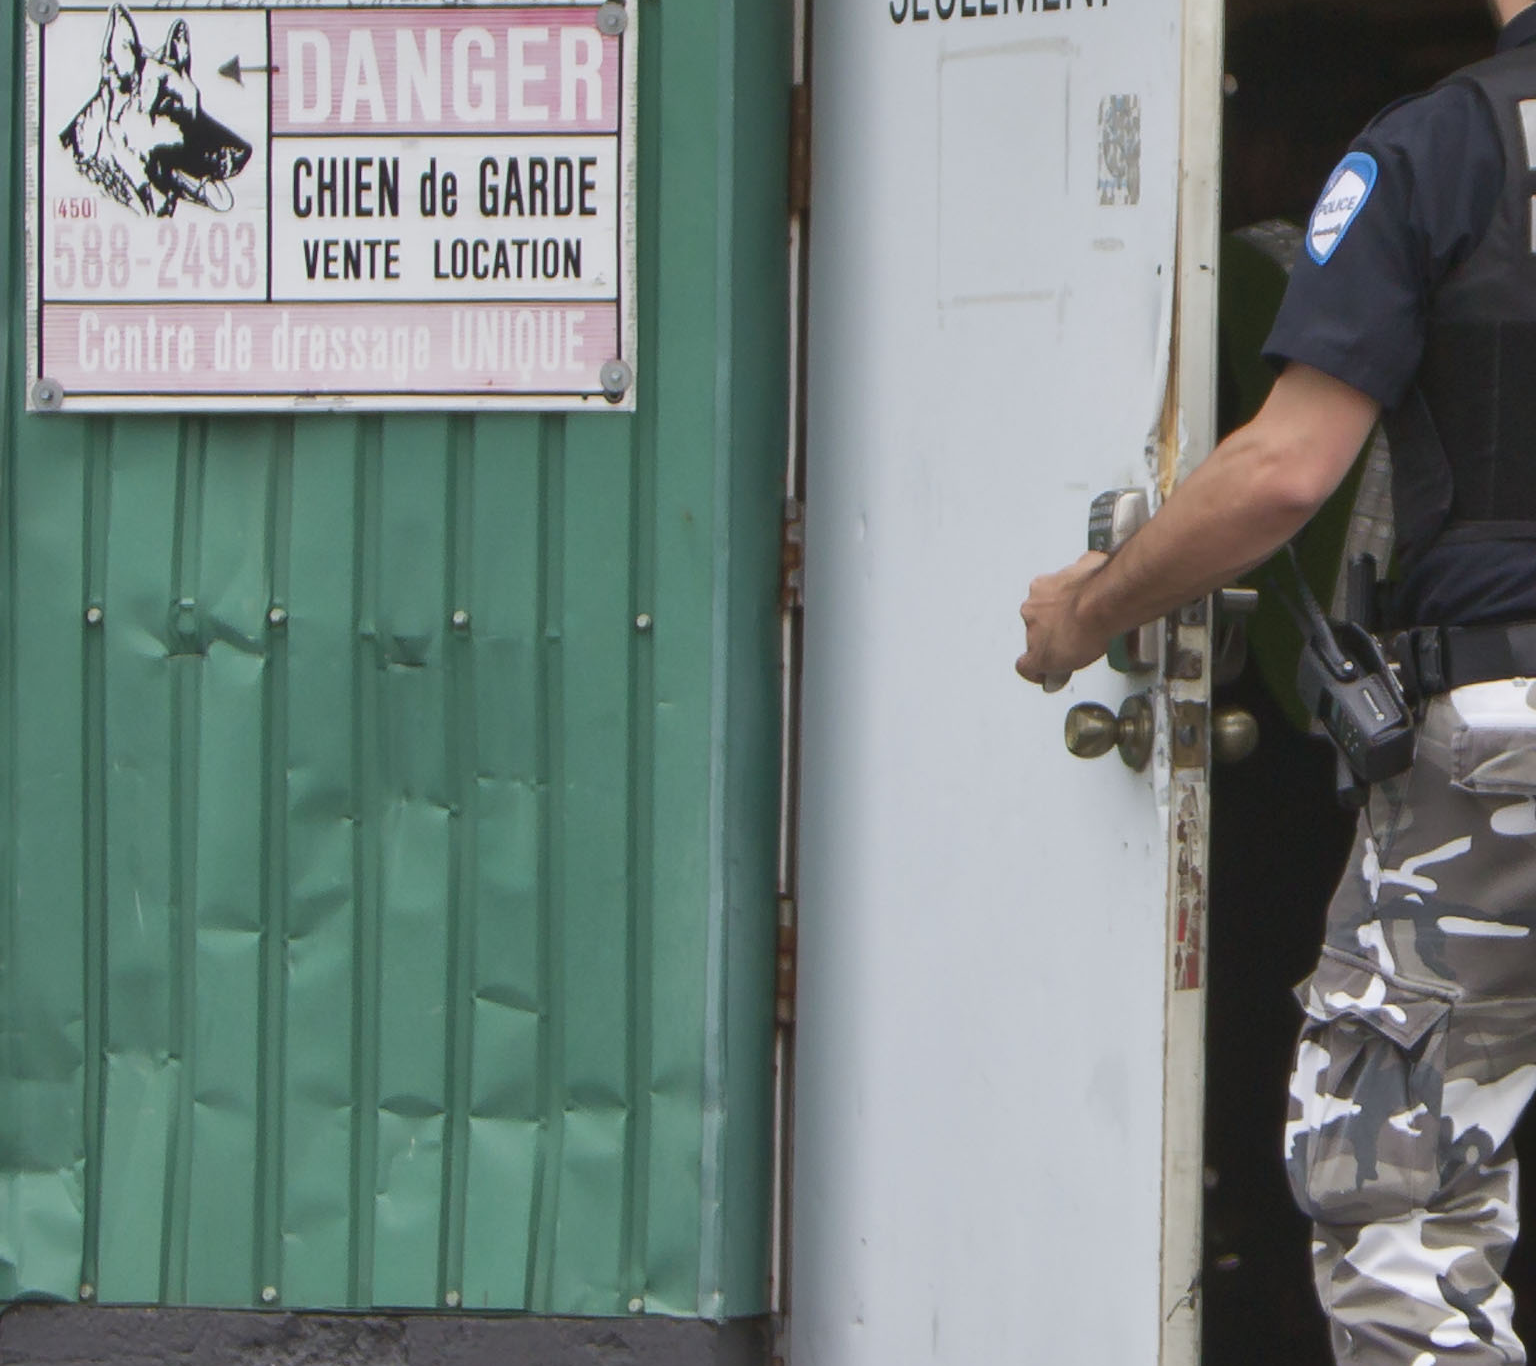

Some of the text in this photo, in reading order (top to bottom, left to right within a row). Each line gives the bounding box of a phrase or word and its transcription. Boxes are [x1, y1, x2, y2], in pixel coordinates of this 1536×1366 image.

[286, 26, 604, 125] DANGER
[52, 196, 98, 220] (450)
[292, 156, 598, 218] CHIEN de GARDE
[52, 221, 258, 291] 588-2493
[303, 239, 582, 280] VENTE LOCATION
[78, 309, 586, 383] Centre de dressage UNIQUE
